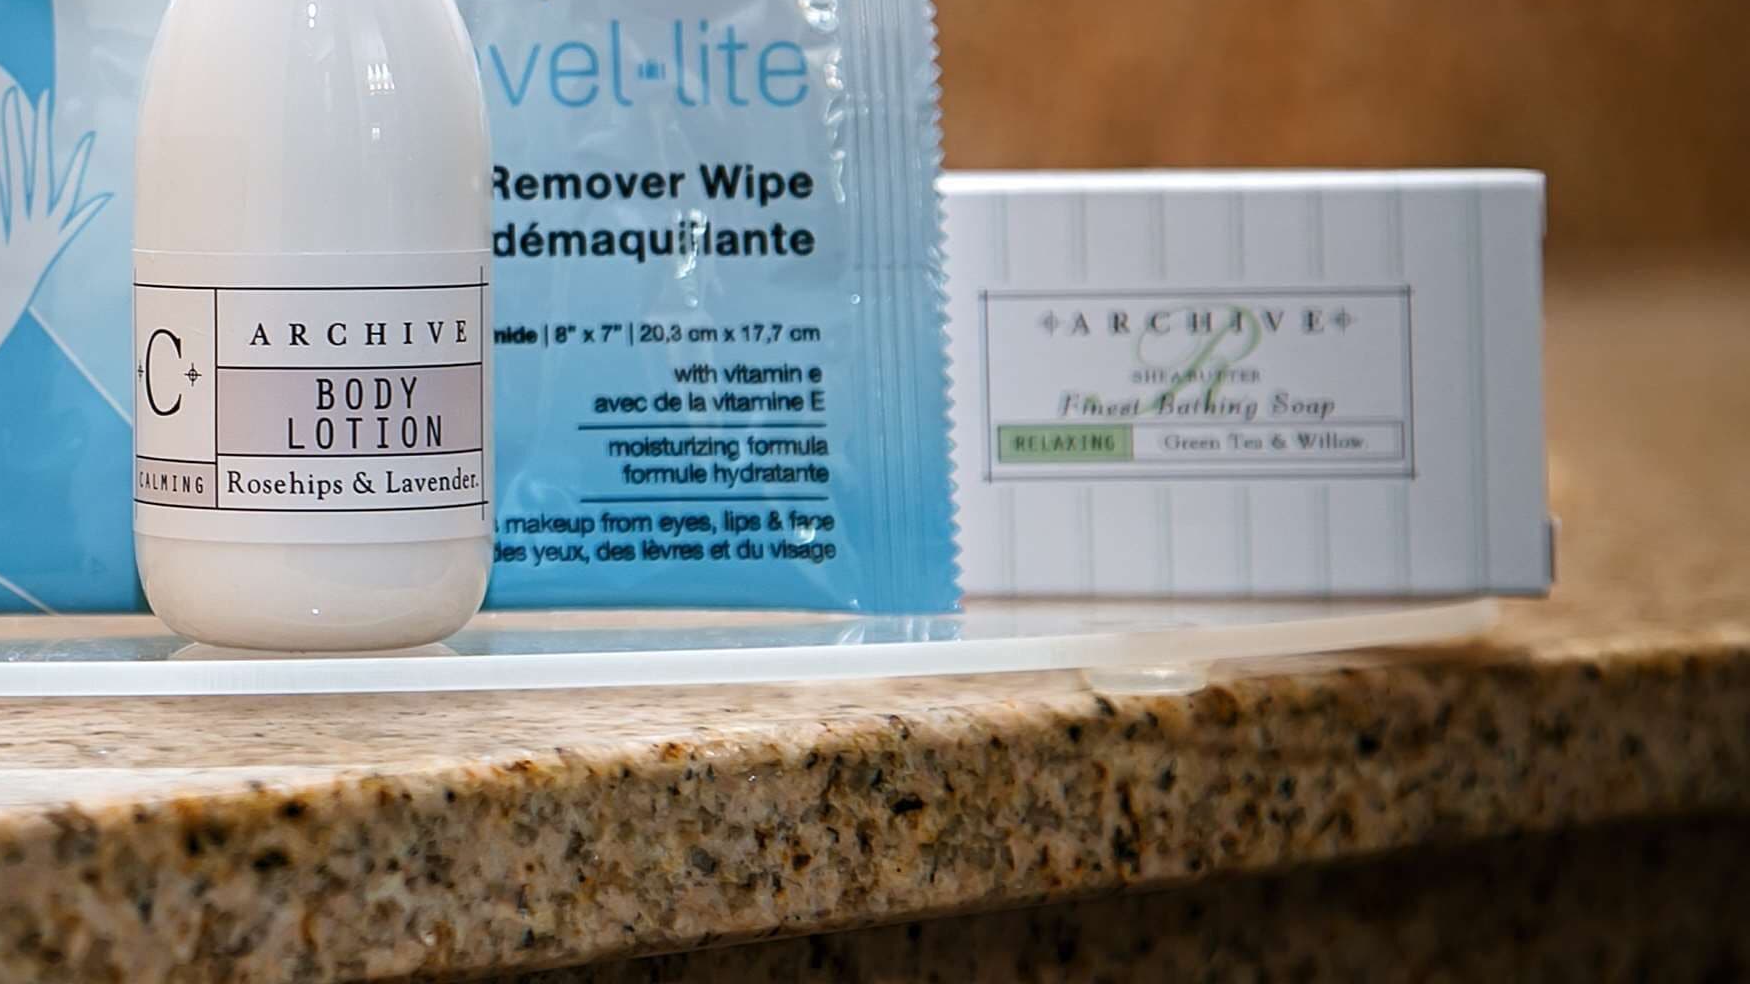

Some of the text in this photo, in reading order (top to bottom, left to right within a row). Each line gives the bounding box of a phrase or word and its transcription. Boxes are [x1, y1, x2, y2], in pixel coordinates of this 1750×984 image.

[700, 163, 815, 207] Wipe
[493, 222, 816, 263] démaquillante
[249, 320, 468, 347] ARCHIVE
[583, 330, 595, 343] x
[640, 324, 683, 344] 20,3
[689, 328, 718, 342] cm
[724, 329, 735, 342] x
[741, 324, 783, 344] 17,7
[789, 328, 821, 342] cm
[1070, 310, 1325, 336] ARCHIVE
[145, 328, 182, 417] C
[674, 364, 823, 383] with vitamin e
[316, 376, 418, 411] BODY
[594, 391, 826, 413] avec de la vitamine E
[1060, 389, 1336, 419] Finest Bathing Soap
[288, 415, 442, 450] LOTION
[1013, 435, 1116, 452] RELAXING
[1164, 434, 1220, 451] Green
[1230, 434, 1263, 450] Tea
[1271, 434, 1287, 450] &
[608, 436, 829, 460] moisturizing formula
[139, 471, 204, 494] CALMING
[226, 466, 480, 500] Rosehips & Lavender.
[622, 464, 830, 488] formule hydratante
[506, 513, 595, 537] makeup
[600, 512, 651, 533] from
[659, 516, 717, 537] eyes,
[724, 510, 761, 535] lips
[767, 510, 783, 531] &
[790, 510, 835, 531] face
[534, 545, 591, 567] yeux,
[595, 539, 636, 561] des
[642, 538, 704, 560] lèvres
[710, 541, 731, 560] et
[737, 539, 764, 559] du
[770, 538, 836, 563] visage
